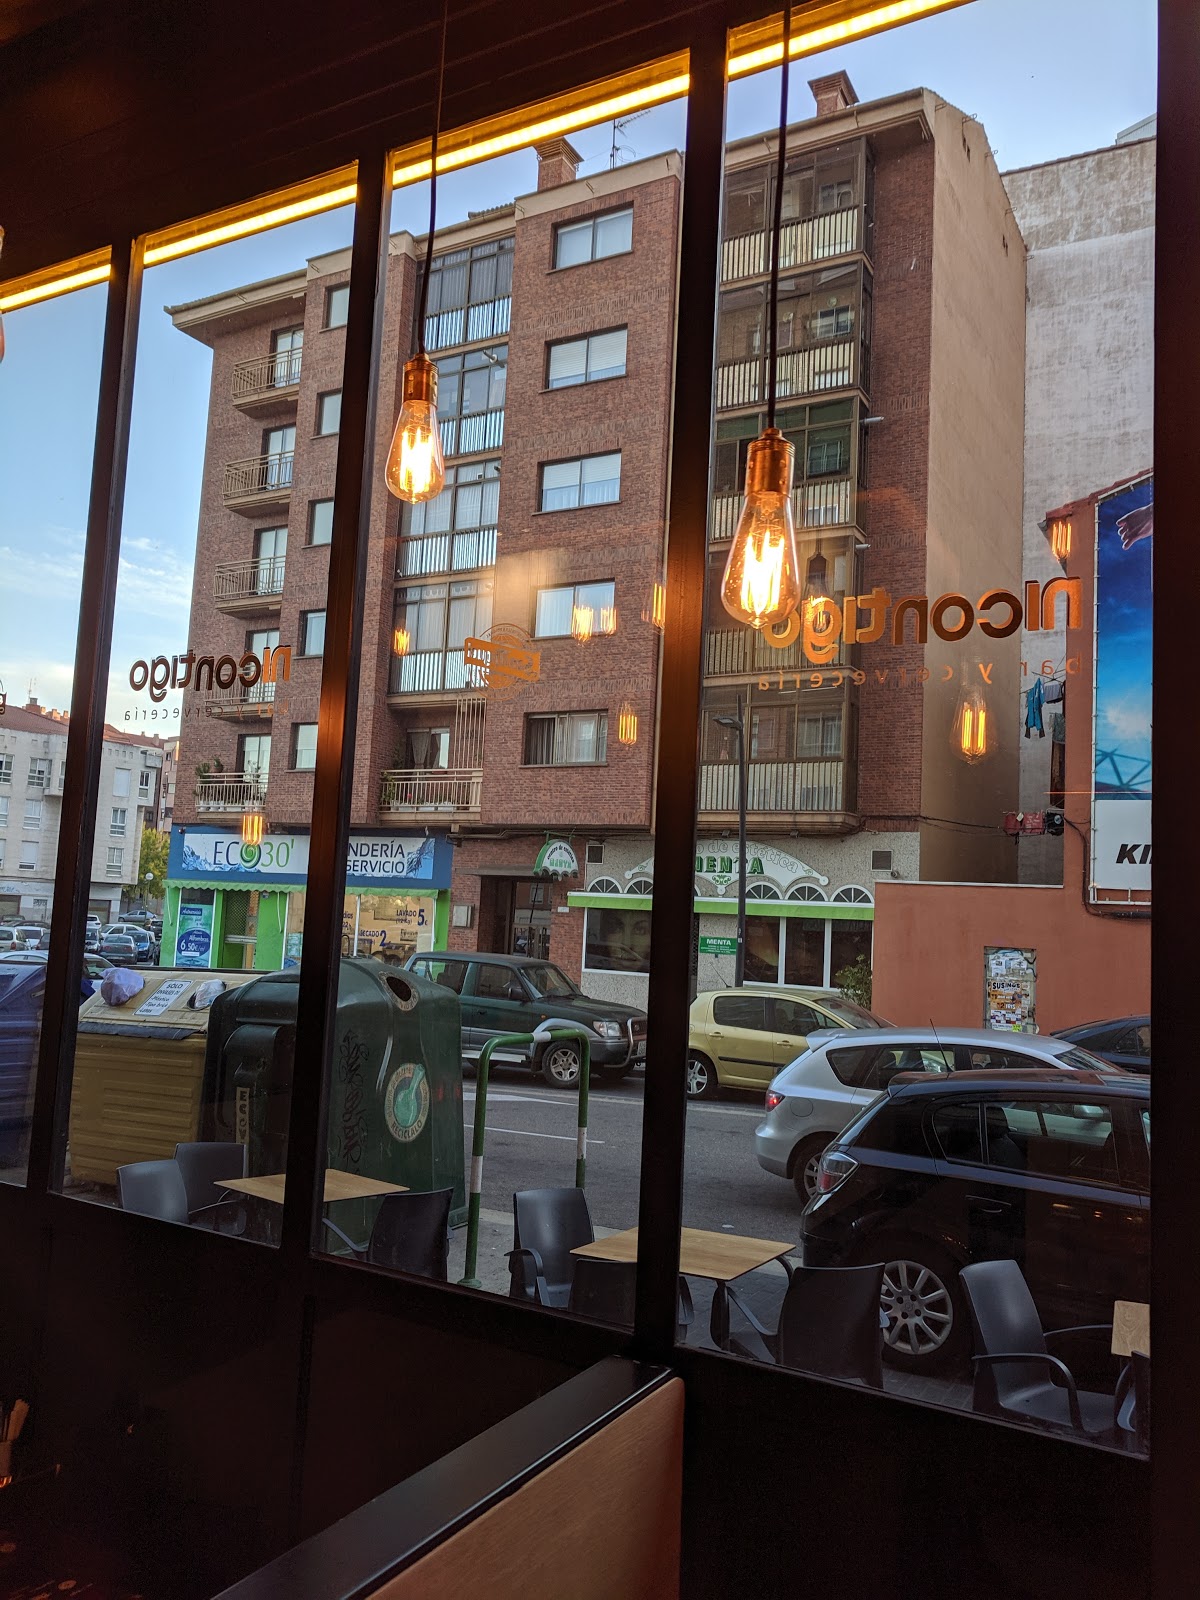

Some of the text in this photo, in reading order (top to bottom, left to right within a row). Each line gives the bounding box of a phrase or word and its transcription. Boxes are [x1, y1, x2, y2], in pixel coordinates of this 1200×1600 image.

[708, 840, 729, 854] de
[1115, 843, 1153, 865] KI
[706, 938, 732, 946] MENTA
